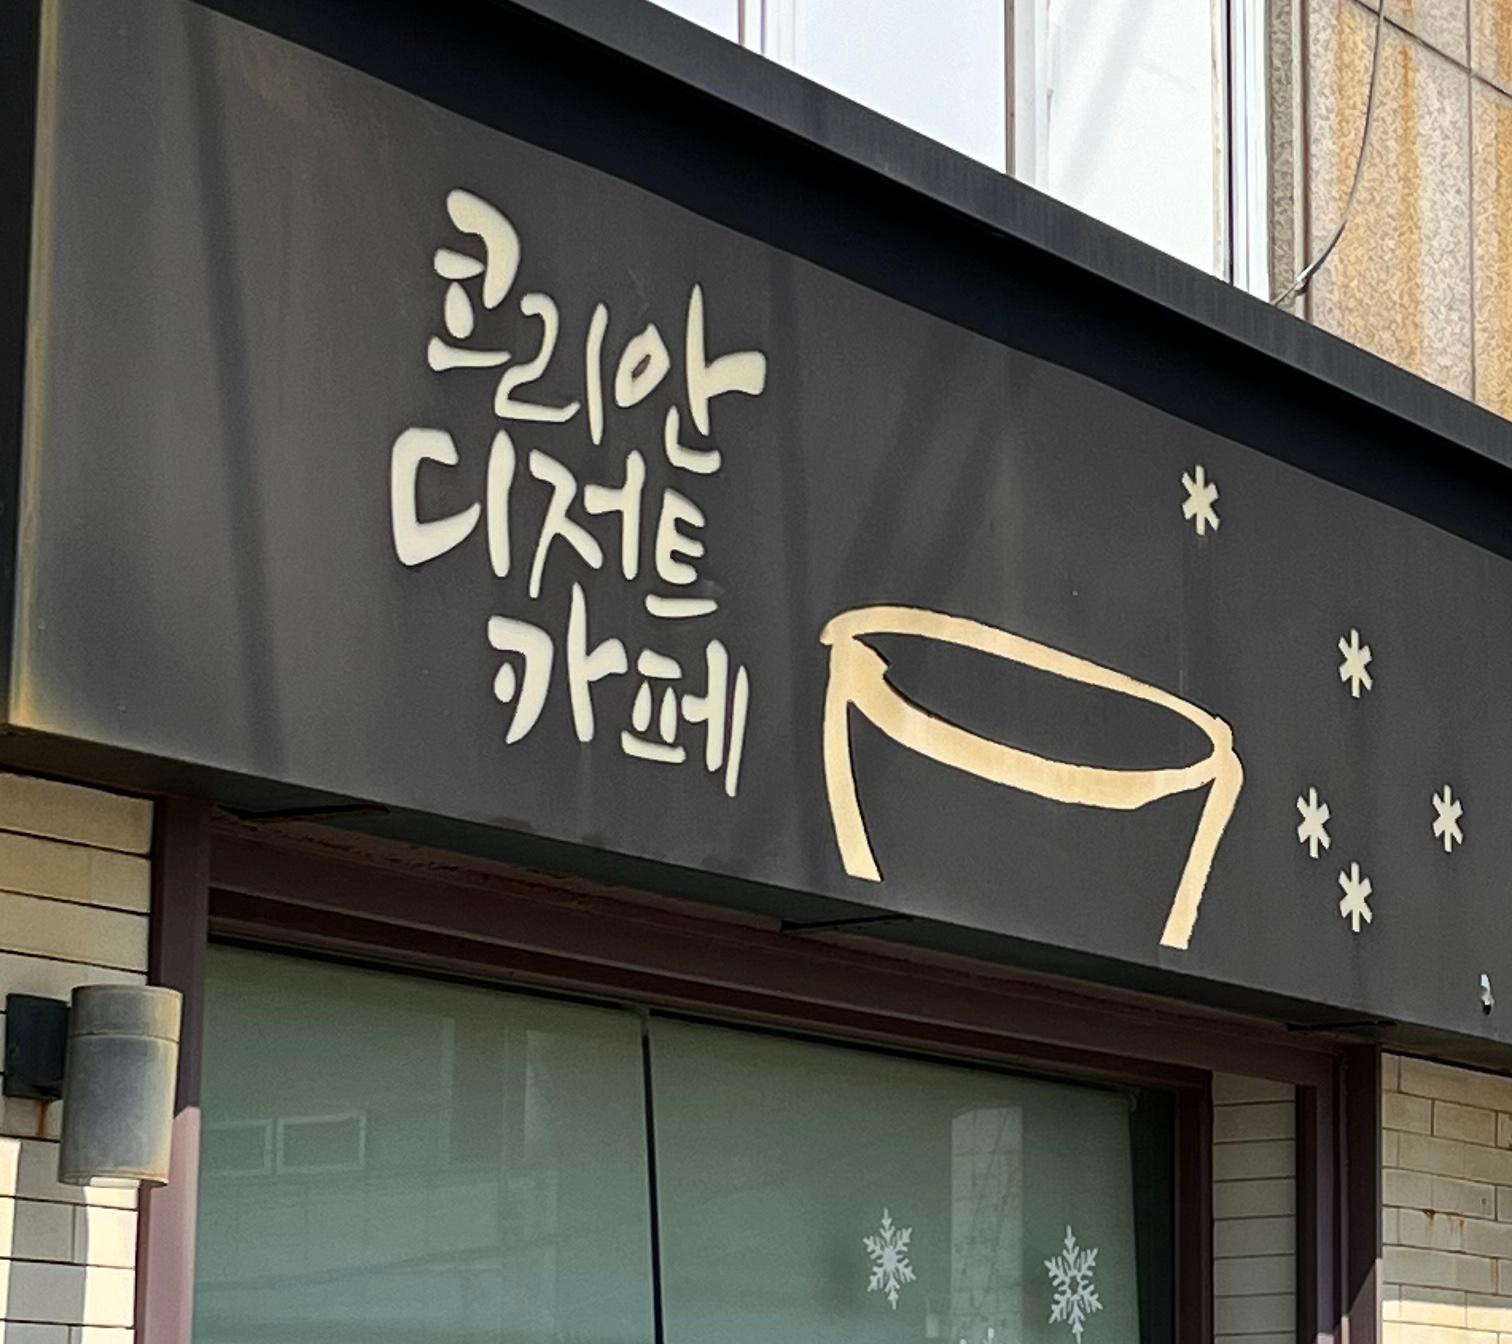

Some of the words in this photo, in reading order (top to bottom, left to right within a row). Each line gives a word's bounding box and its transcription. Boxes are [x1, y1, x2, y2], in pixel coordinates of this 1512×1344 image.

[427, 188, 767, 475] 코리안
[390, 428, 720, 618] 디저트
[487, 582, 749, 798] 카페
